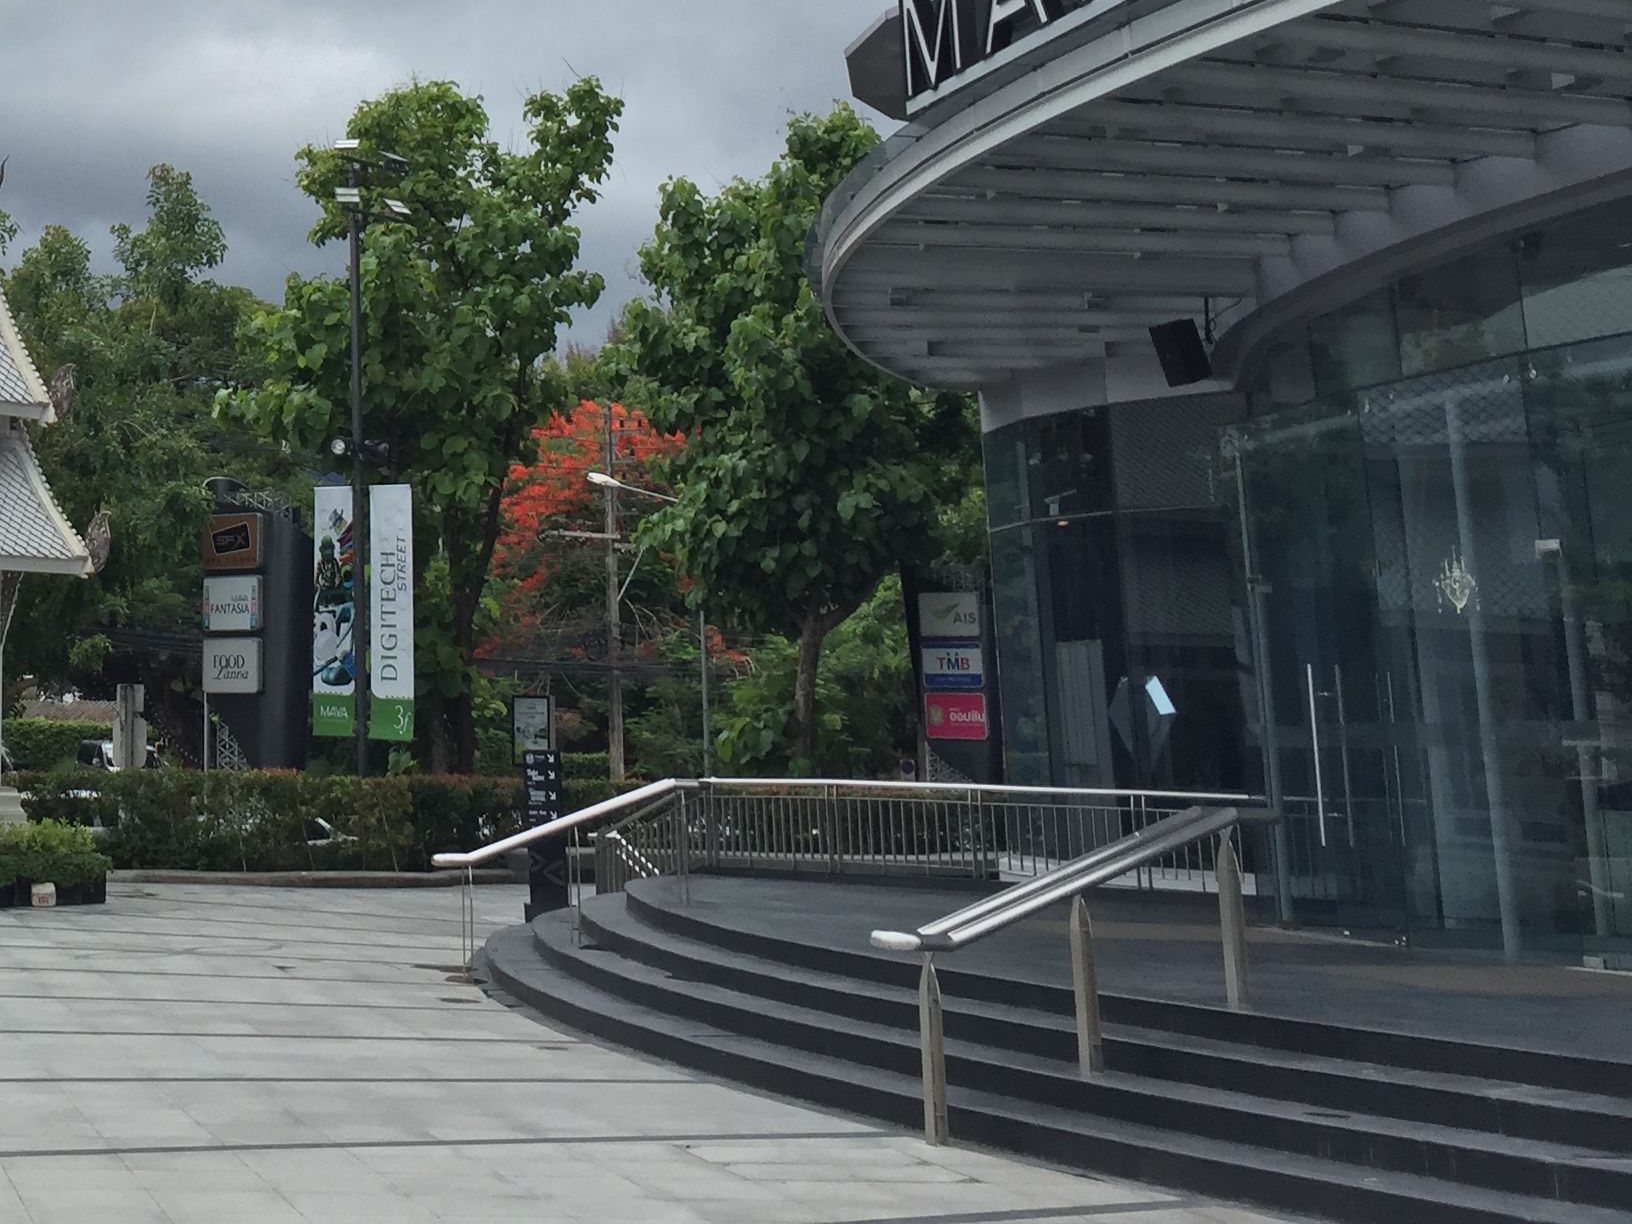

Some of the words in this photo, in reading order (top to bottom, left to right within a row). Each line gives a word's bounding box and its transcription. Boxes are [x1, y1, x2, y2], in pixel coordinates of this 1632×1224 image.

[396, 535, 408, 592] STREET
[210, 602, 250, 614] FANTASIA
[380, 551, 397, 682] DIGITECH
[953, 612, 977, 625] AIS
[213, 654, 245, 669] FOOD
[936, 656, 971, 671] TMB
[320, 705, 349, 718] MAYA
